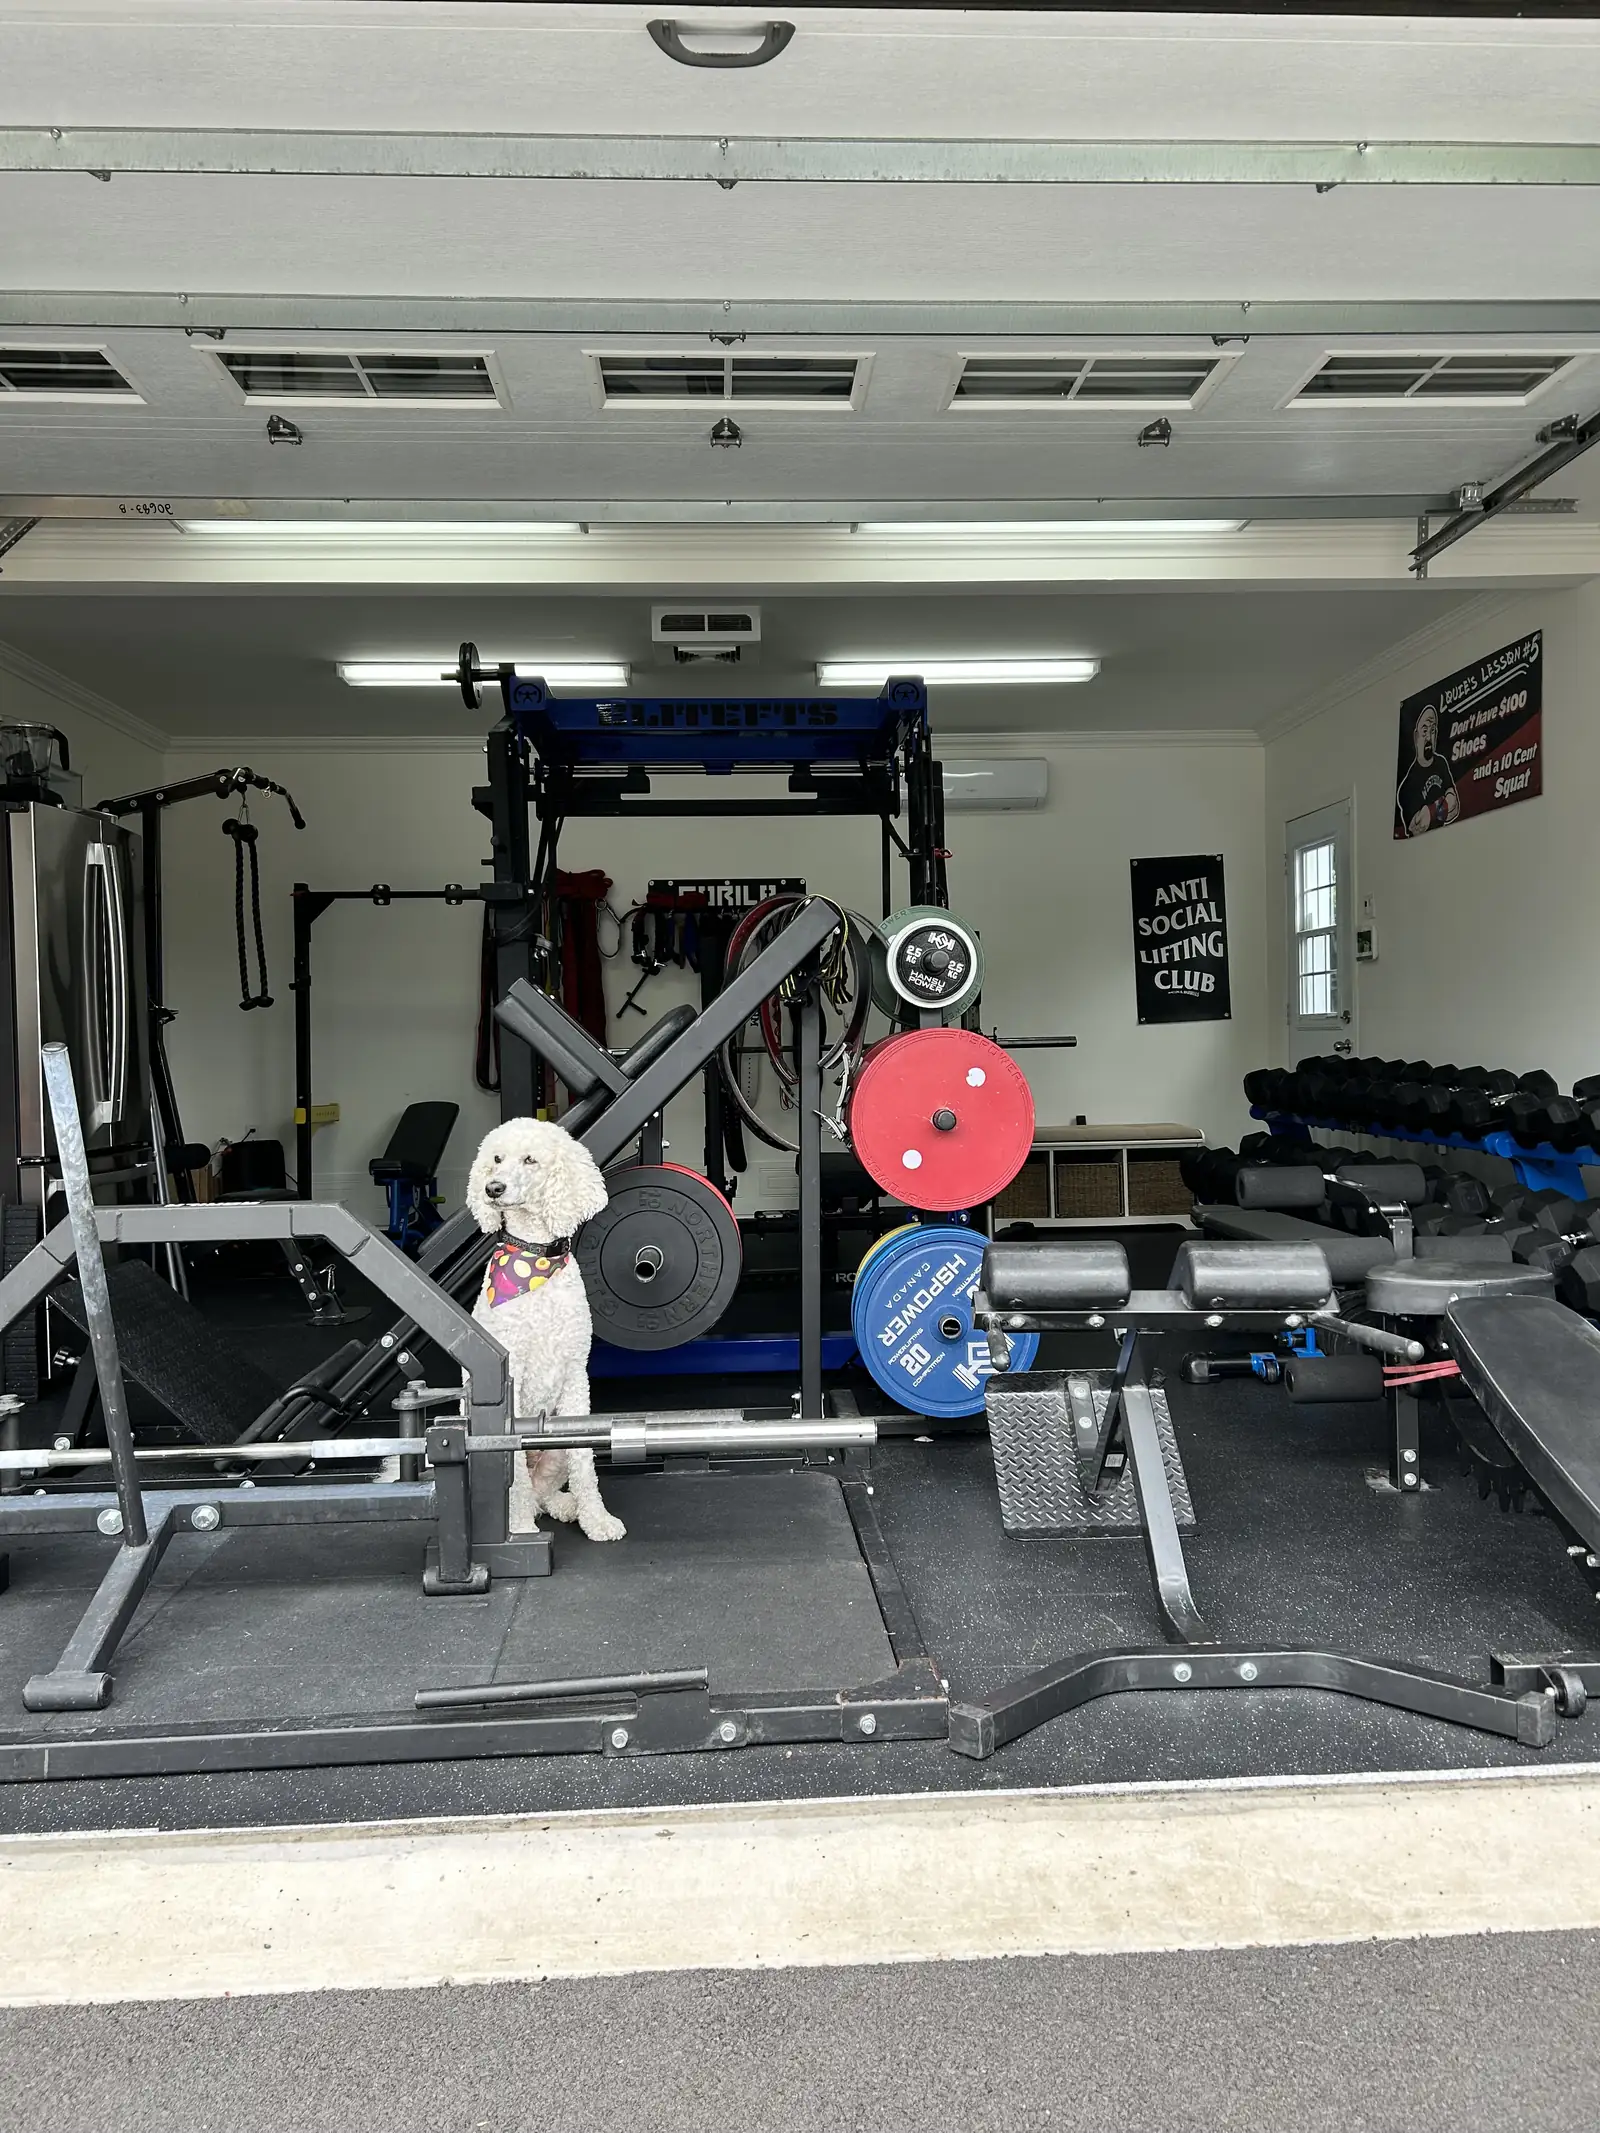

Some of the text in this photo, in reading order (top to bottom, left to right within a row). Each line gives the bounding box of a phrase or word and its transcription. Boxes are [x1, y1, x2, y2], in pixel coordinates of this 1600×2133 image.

[1439, 633, 1540, 713] LOUIE'S LESSON #5
[1449, 690, 1528, 738] Don't have $100
[1451, 734, 1487, 761] Shoes
[1473, 742, 1538, 780] and a 10 Cent
[1494, 767, 1531, 799] Squat
[1154, 876, 1209, 907] ANTI
[1138, 901, 1223, 936] SOCIAL
[905, 955, 917, 964] KG
[1139, 930, 1224, 964] LIFTING
[908, 975, 943, 993] POWER
[910, 969, 946, 988] HANSU
[947, 970, 958, 980] KG
[1154, 969, 1216, 993] CLUB
[664, 1200, 720, 1326] NORTHERN
[877, 1253, 967, 1347] HSPOWER
[885, 1262, 931, 1309] CANADA
[900, 1343, 932, 1377] 20
[912, 1351, 946, 1387] COMPETITION
